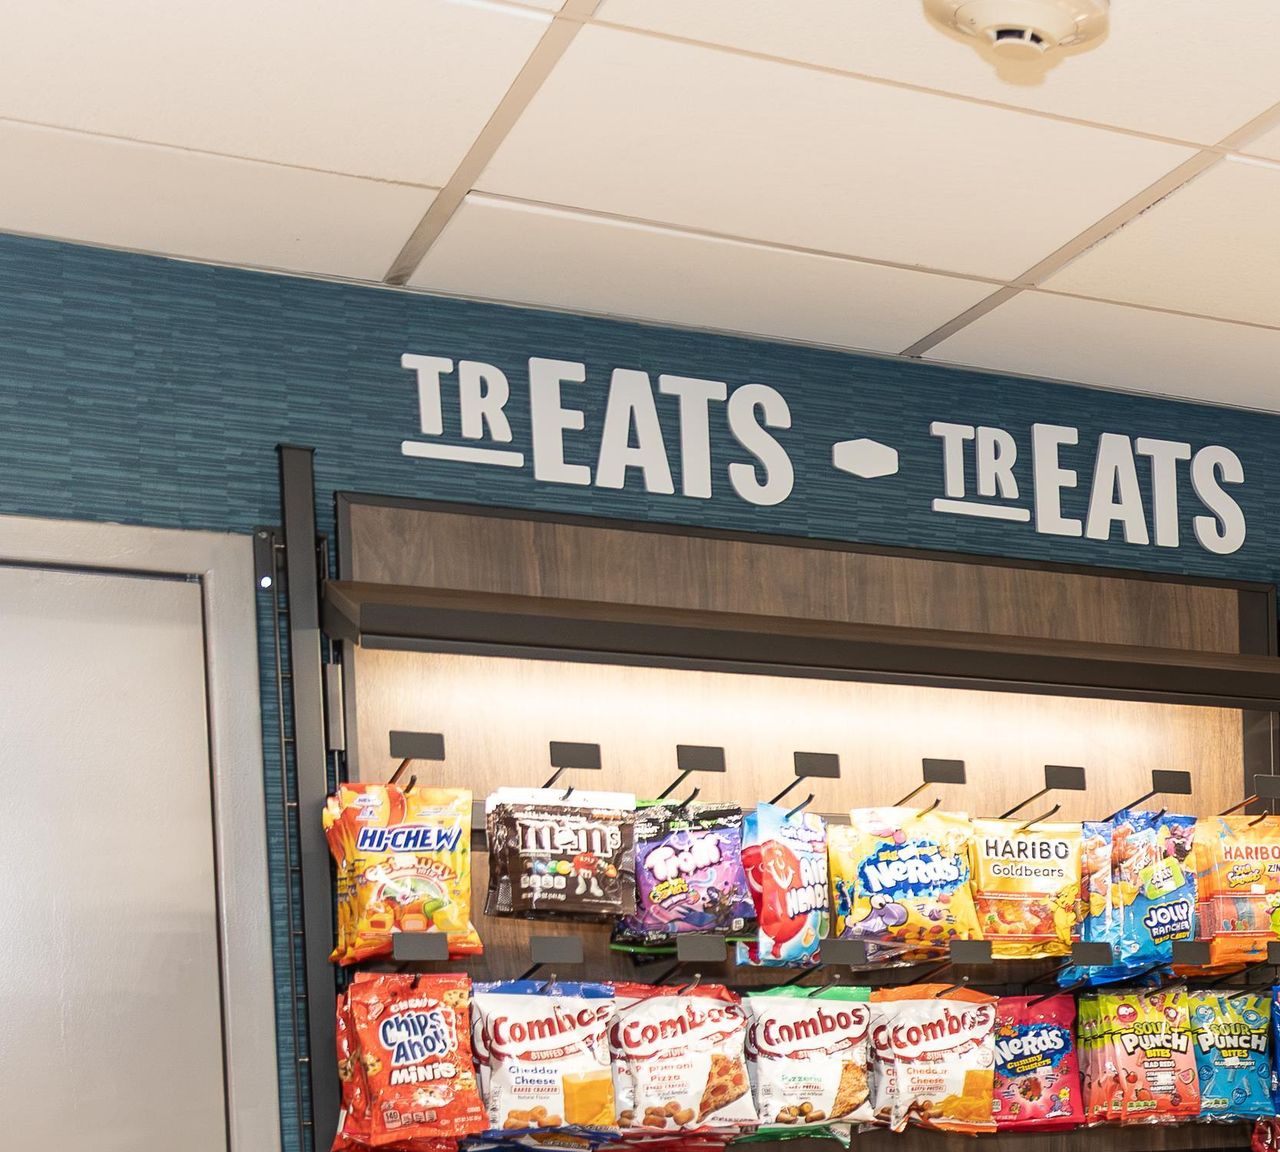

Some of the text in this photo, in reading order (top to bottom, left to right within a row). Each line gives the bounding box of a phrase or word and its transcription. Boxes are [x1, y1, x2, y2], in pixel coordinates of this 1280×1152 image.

[401, 353, 794, 506] TREATS
[930, 421, 1247, 555] TREATS
[358, 828, 462, 852] HI-CHEW
[991, 863, 1064, 878] Goldbears
[1145, 900, 1190, 927] JOLLY
[382, 1010, 441, 1044] Chips
[493, 1001, 611, 1044] Combos
[624, 1003, 738, 1048] Combos
[763, 1006, 865, 1047] Combos
[892, 1004, 990, 1049] Combos
[1133, 1022, 1170, 1034] SOUR
[1211, 1023, 1251, 1035] SOUR
[1120, 1032, 1189, 1054] PUNCH
[1145, 1048, 1171, 1059] BITES
[1198, 1032, 1268, 1054] PUNCH
[1221, 1049, 1249, 1059] BITES
[1006, 1054, 1043, 1070] Gummy
[1016, 1058, 1051, 1074] Clusters
[514, 1076, 556, 1085] Cheese
